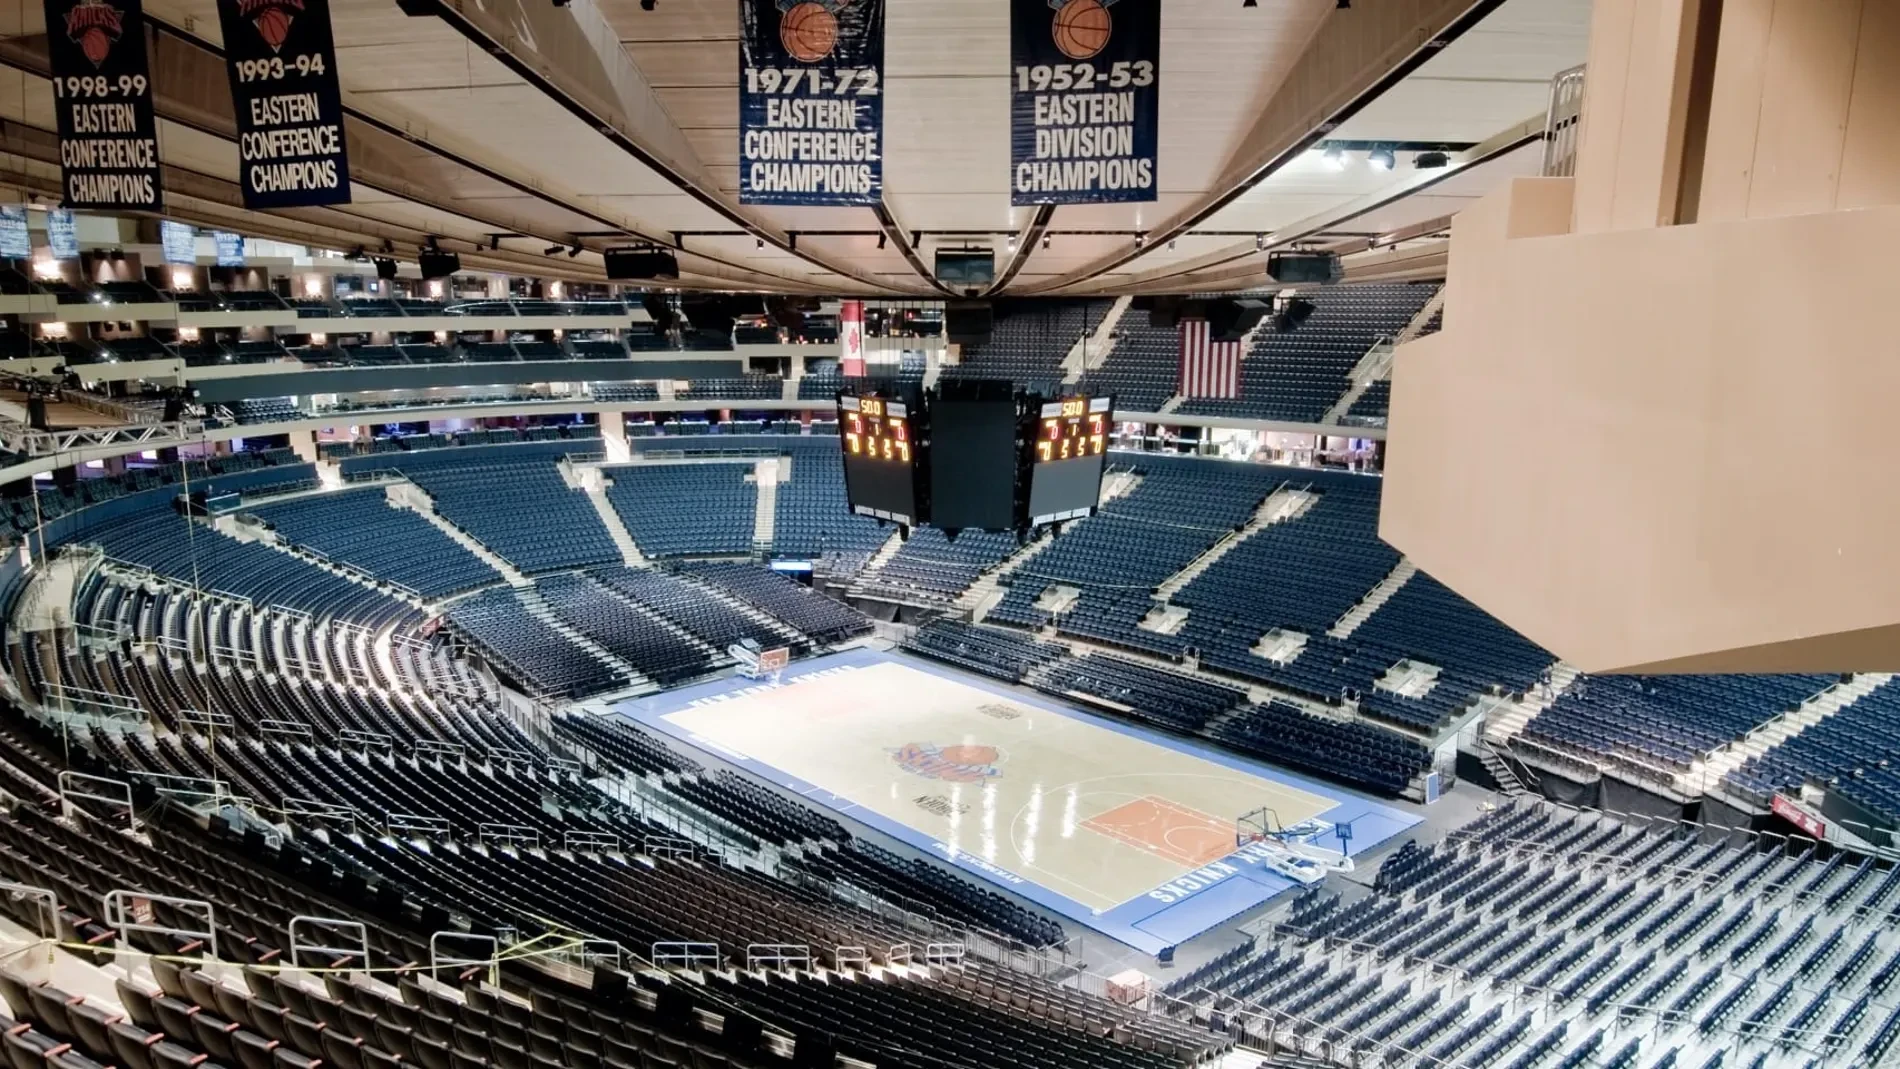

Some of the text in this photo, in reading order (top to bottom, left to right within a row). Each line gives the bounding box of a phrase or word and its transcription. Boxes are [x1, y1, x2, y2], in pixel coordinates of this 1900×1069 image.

[235, 53, 325, 83] 1993-94
[744, 67, 879, 96] 1971-72
[1015, 60, 1154, 92] 1952-53
[54, 75, 147, 98] 1998-99
[73, 104, 136, 133] EASTERN
[251, 93, 320, 126] EASTERN
[767, 98, 857, 130] EASTERN
[1034, 91, 1134, 126] EASTERN
[61, 139, 156, 169] CONFERENCE
[242, 126, 340, 161] CONFERENCE
[744, 130, 877, 161] CONFERENCE
[1035, 126, 1133, 158] DIVISION
[69, 174, 155, 204] CHAMPIONS
[251, 160, 338, 194] CHAMPIONS
[750, 162, 871, 194] CHAMPIONS
[1016, 158, 1152, 193] CHAMPIONS
[1149, 861, 1239, 903] KNICKS
